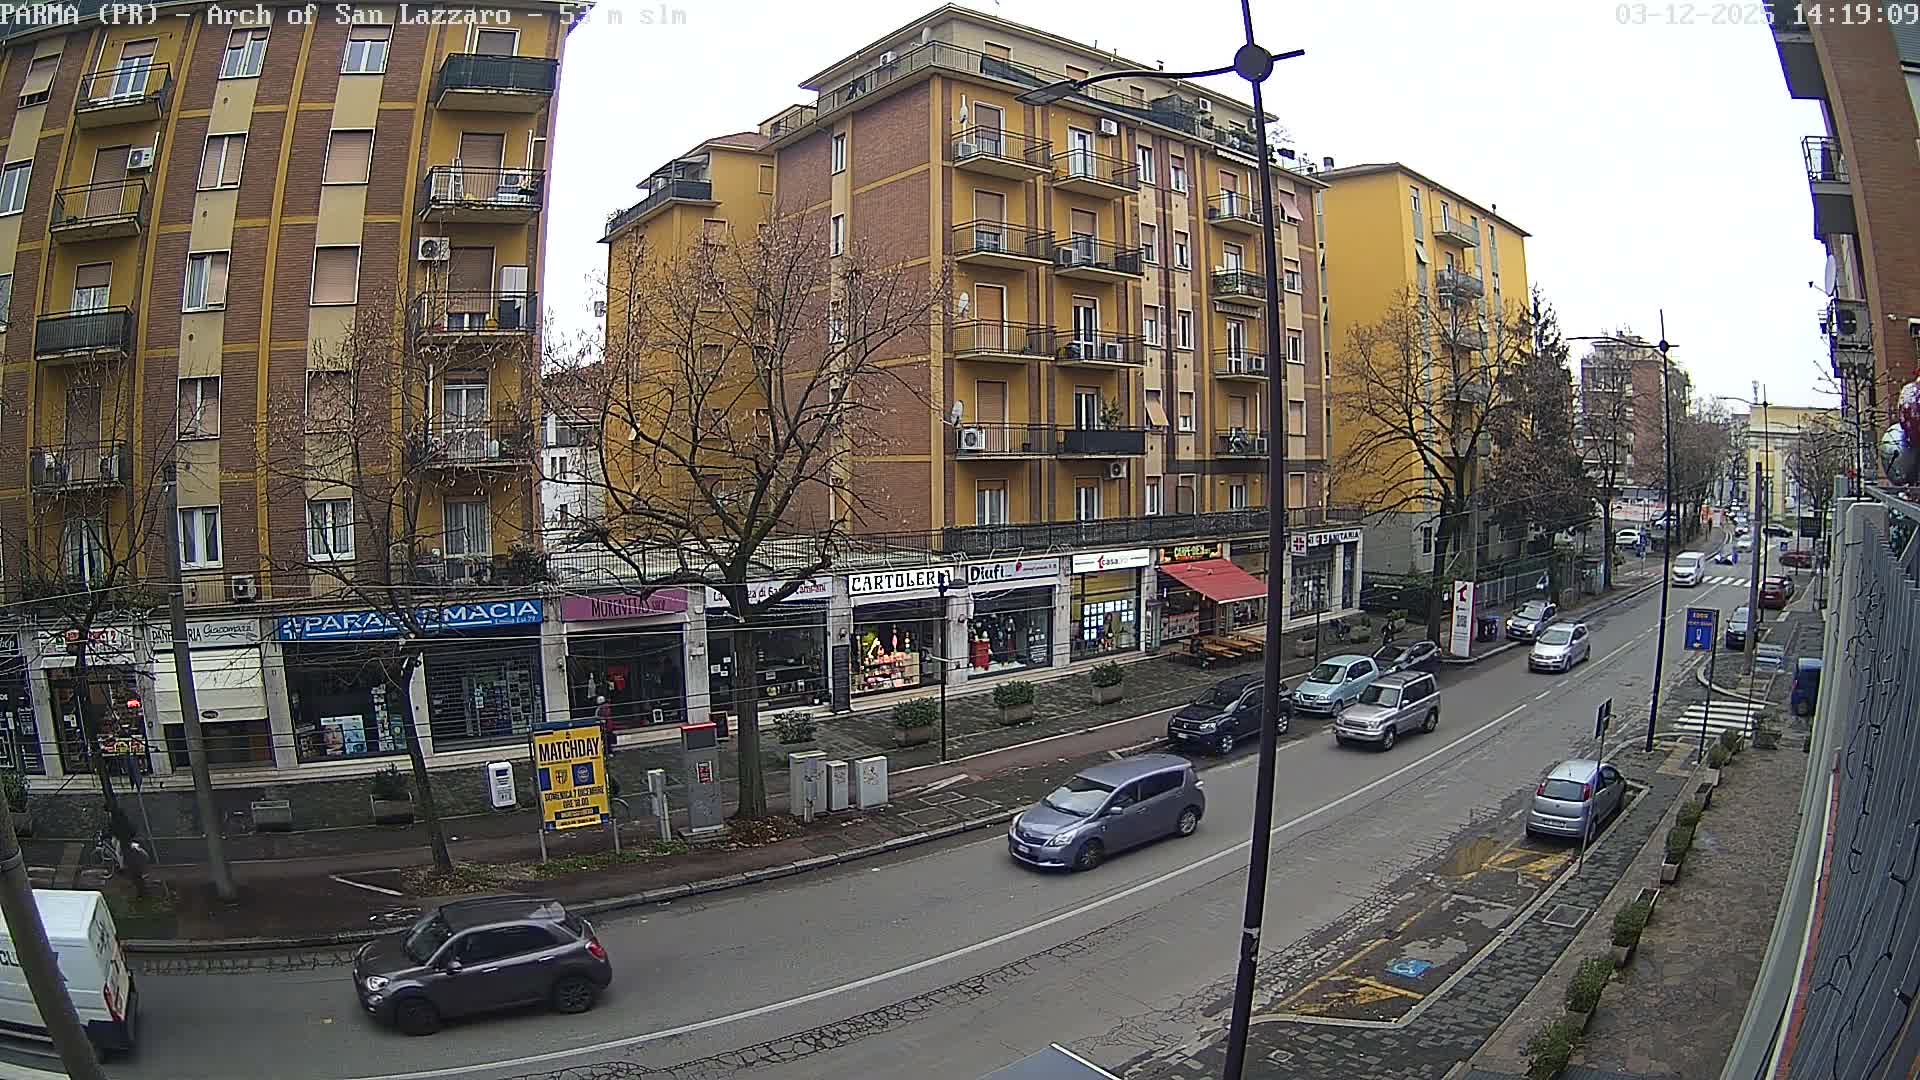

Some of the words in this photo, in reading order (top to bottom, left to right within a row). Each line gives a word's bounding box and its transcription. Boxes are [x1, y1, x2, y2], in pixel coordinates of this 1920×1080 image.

[852, 569, 951, 591] CARTOLERIA
[305, 602, 538, 631] PARAFRMACIA
[539, 737, 600, 762] MATCHDAY
